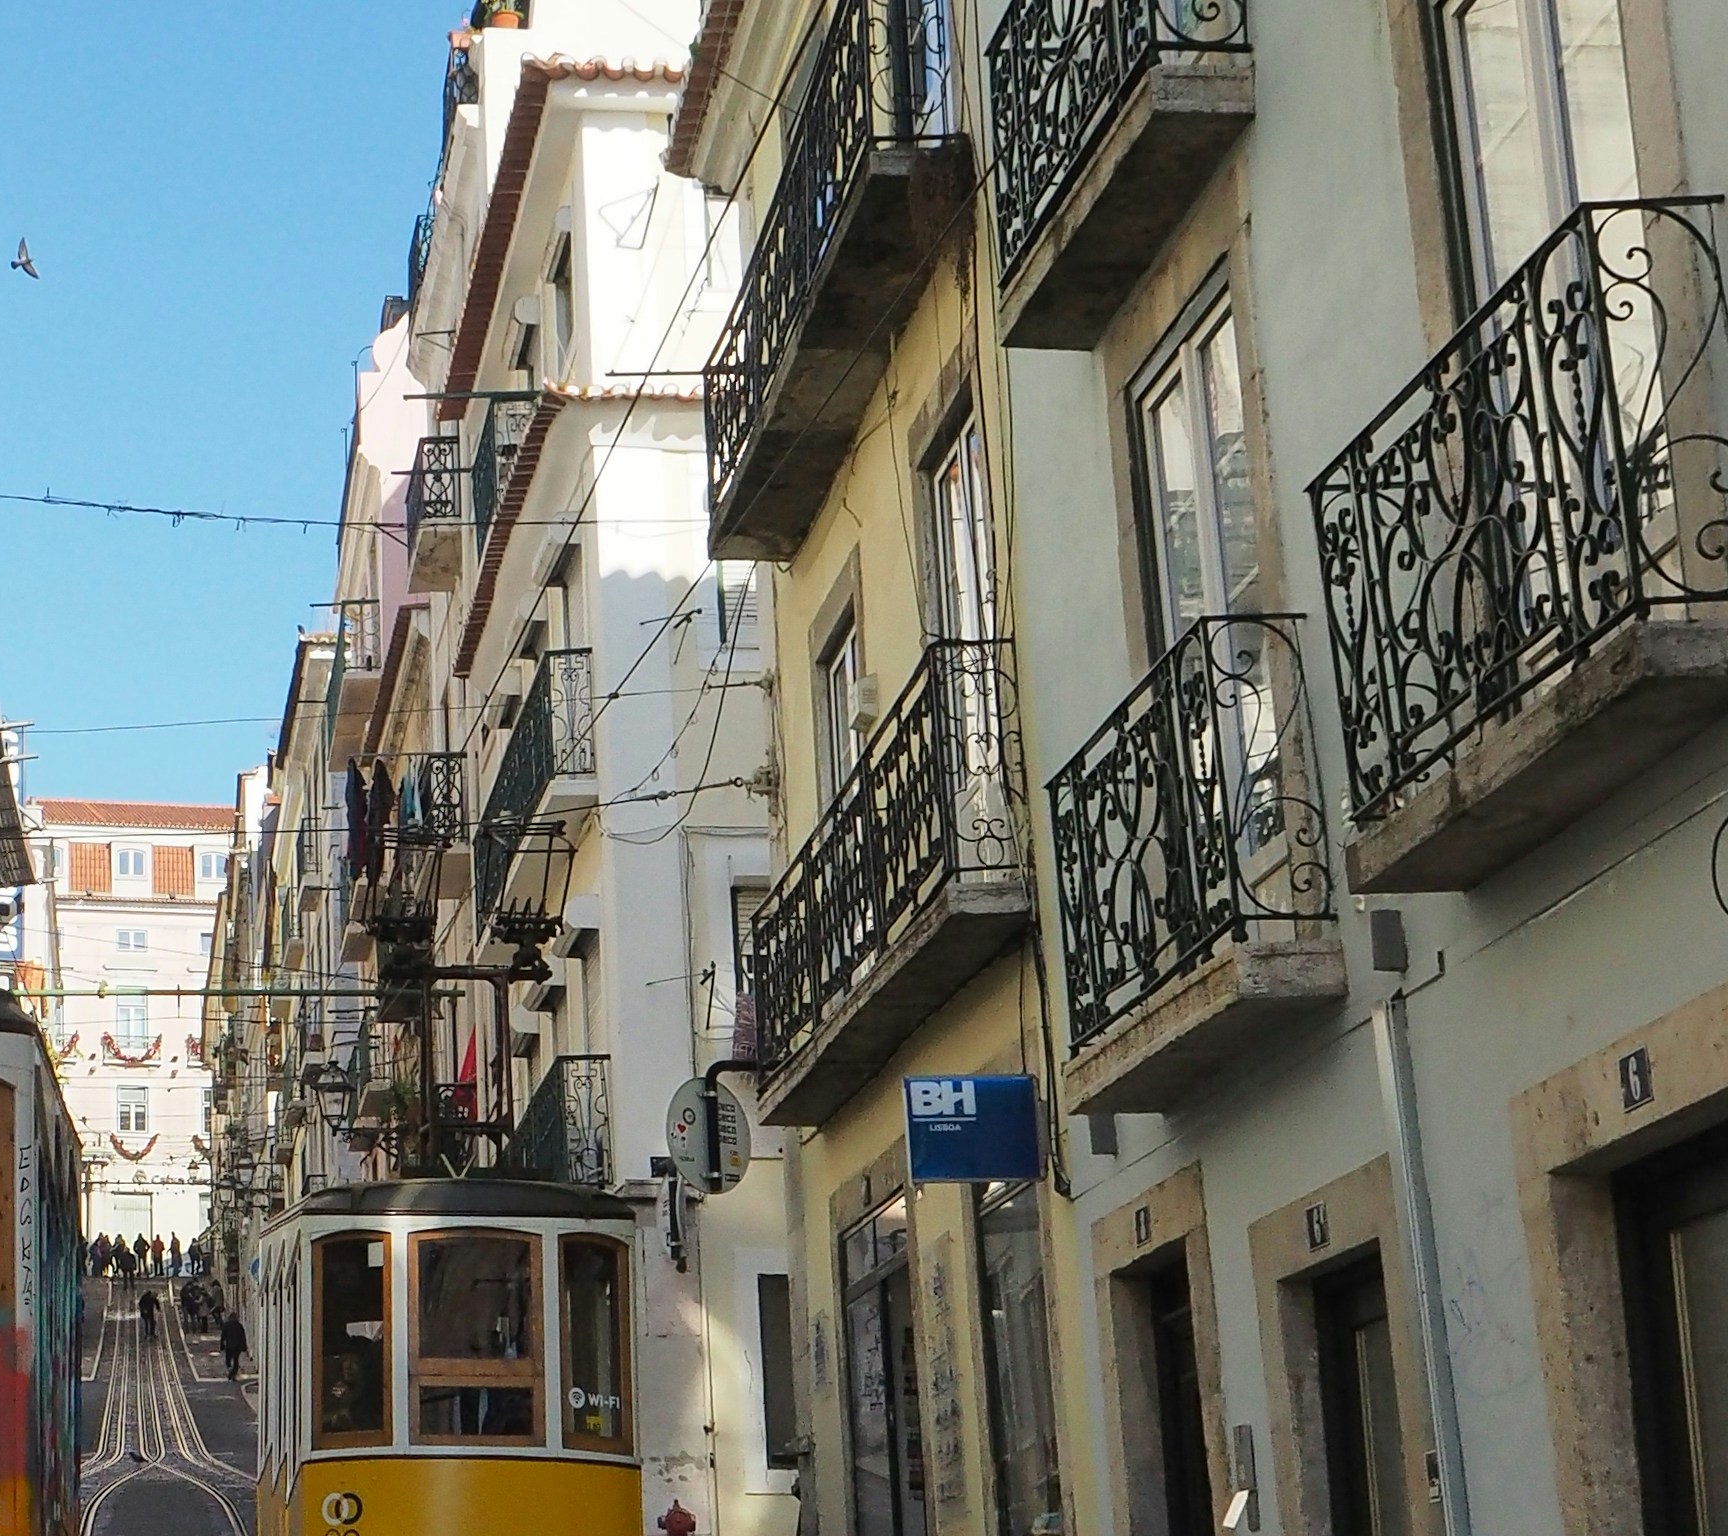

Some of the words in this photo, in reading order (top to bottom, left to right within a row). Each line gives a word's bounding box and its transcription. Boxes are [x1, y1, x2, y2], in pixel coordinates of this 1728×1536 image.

[1628, 1055, 1642, 1101] 6
[909, 1080, 977, 1116] BH
[929, 1123, 962, 1132] LISBOA
[587, 1392, 621, 1410] WI-FI
